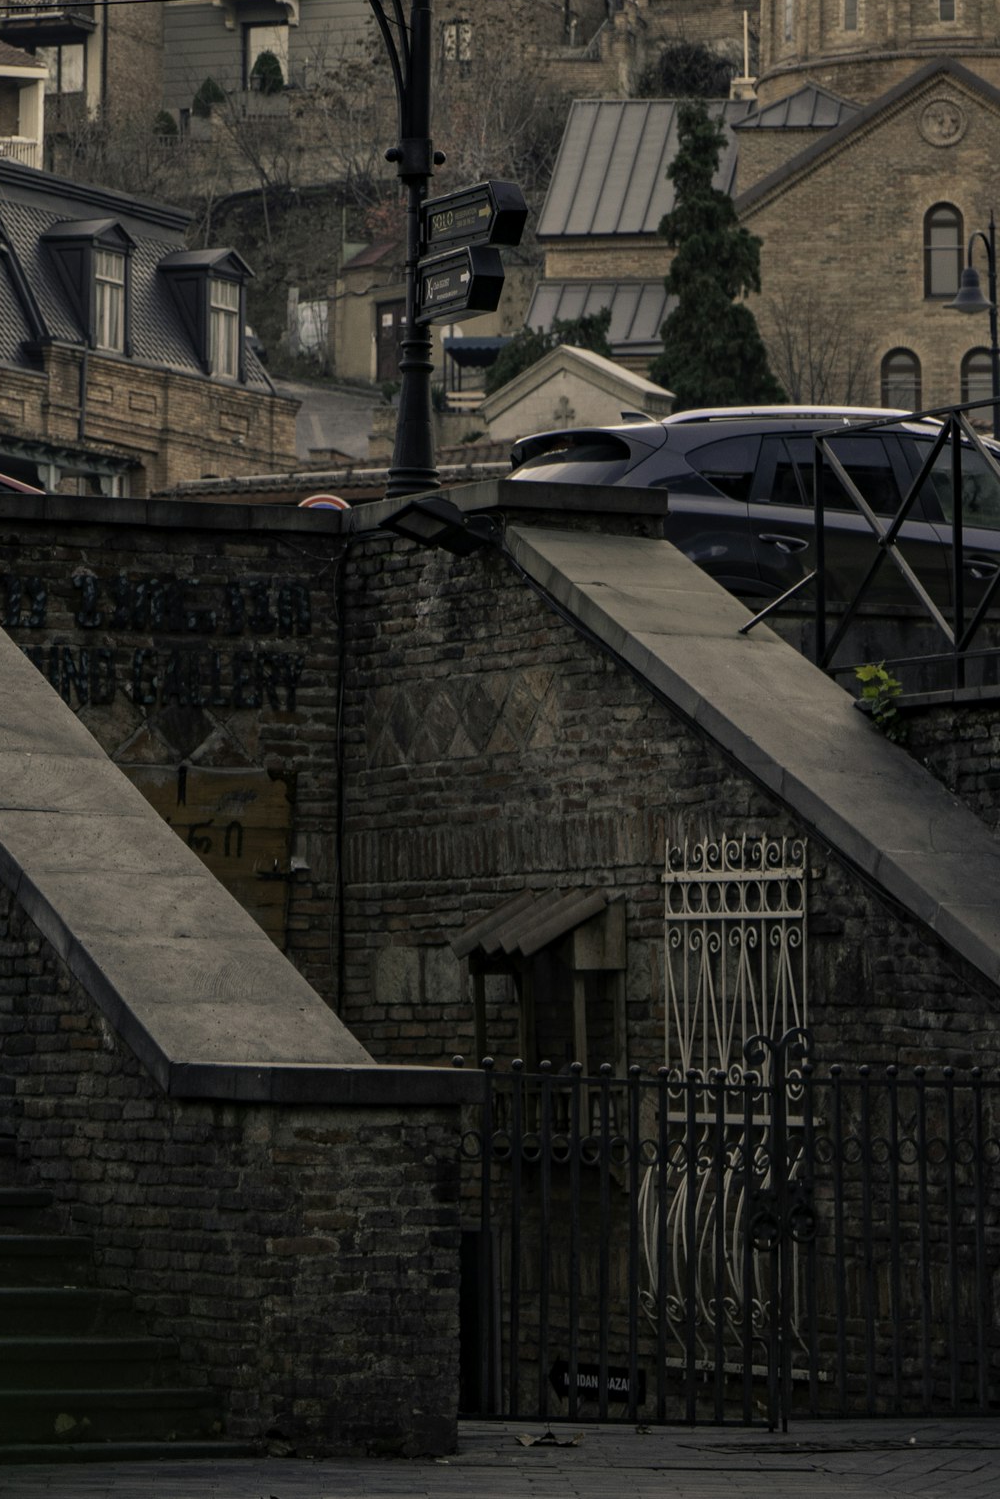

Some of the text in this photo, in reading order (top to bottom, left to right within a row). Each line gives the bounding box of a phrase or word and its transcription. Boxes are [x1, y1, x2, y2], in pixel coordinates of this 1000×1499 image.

[432, 210, 454, 229] SOLO
[563, 1372, 631, 1392] MIDAN AZA
